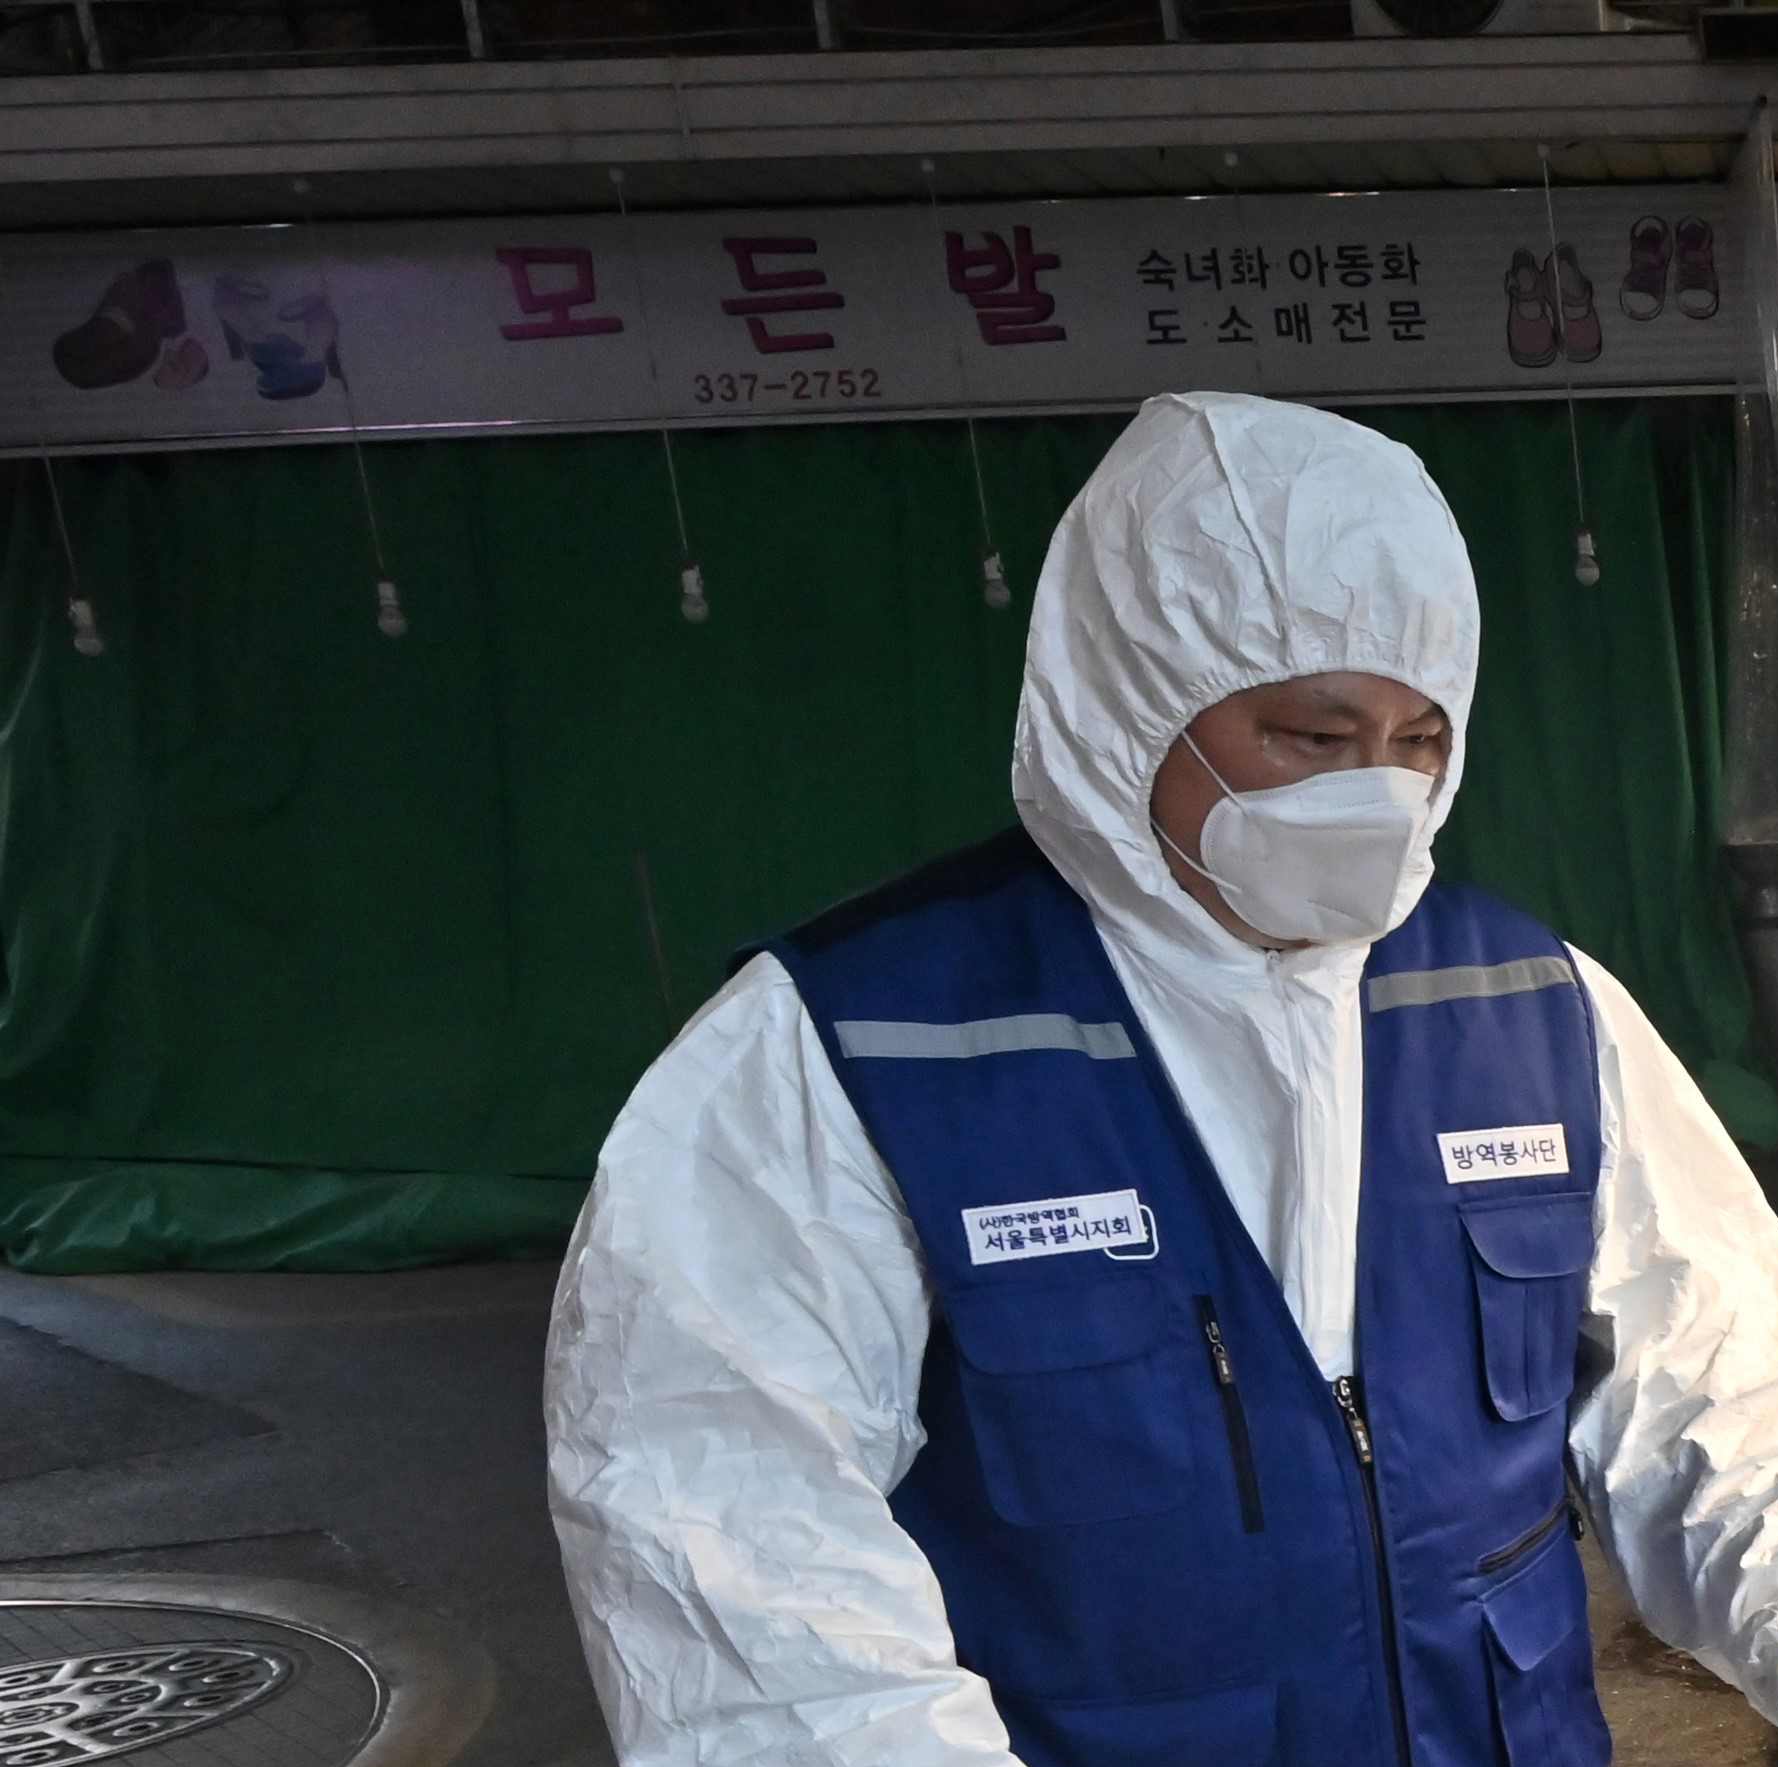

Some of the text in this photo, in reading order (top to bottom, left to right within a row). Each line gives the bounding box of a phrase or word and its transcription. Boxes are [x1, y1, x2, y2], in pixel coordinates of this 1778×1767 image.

[1136, 241, 1421, 291] 숙녀화 아동화
[694, 368, 882, 403] 337-2752
[1451, 1140, 1556, 1170] 방역봉사단
[985, 1216, 1133, 1252] 서울특별시지회
